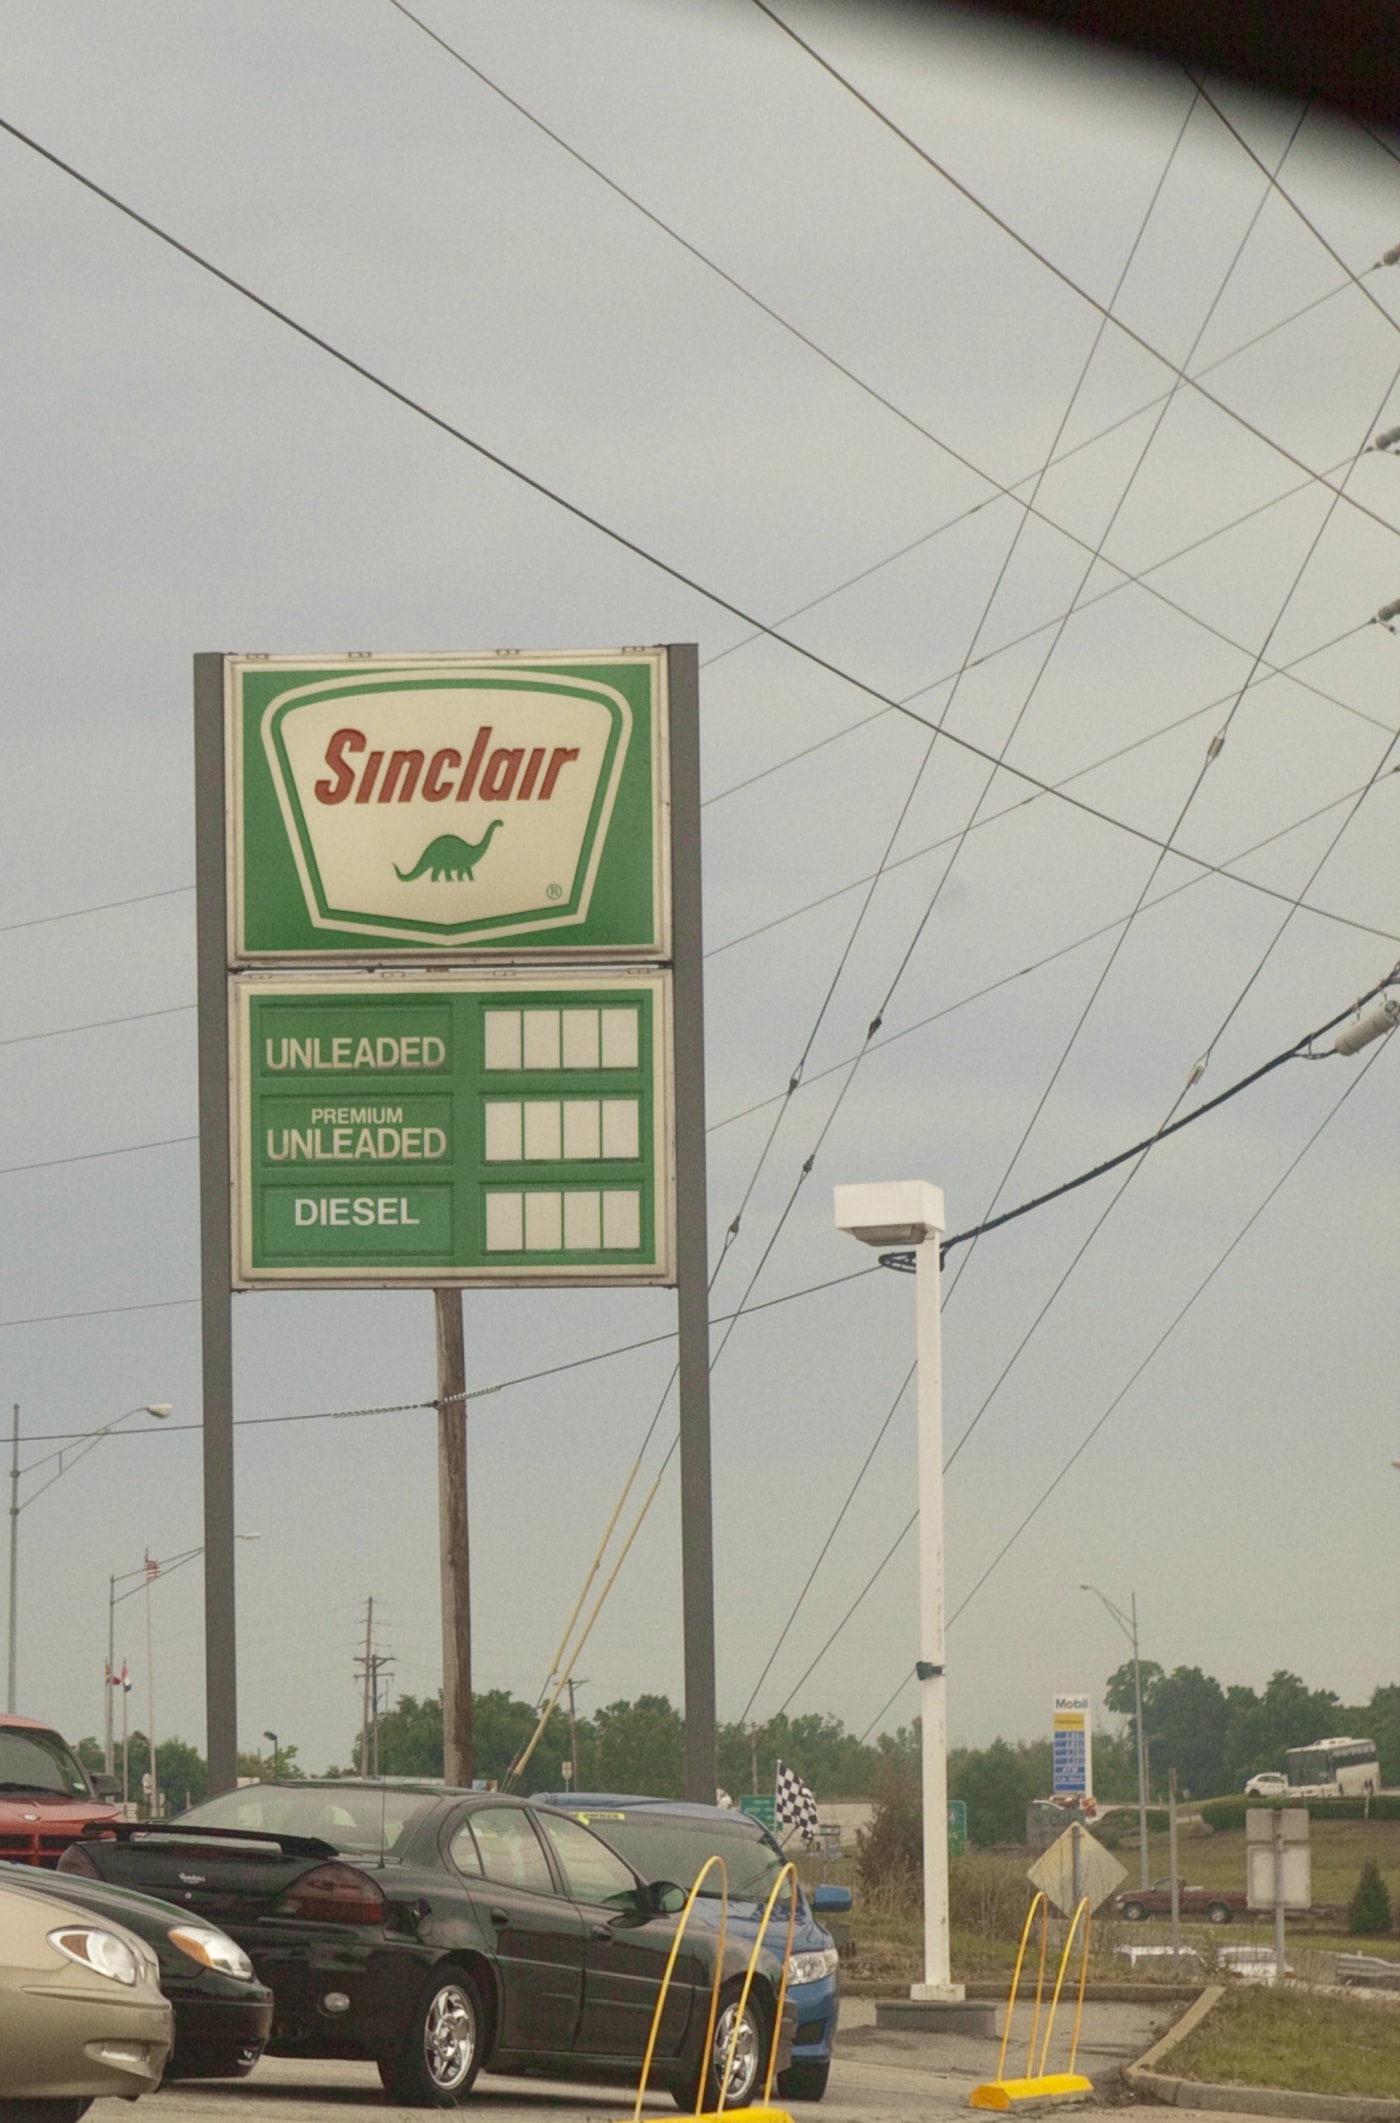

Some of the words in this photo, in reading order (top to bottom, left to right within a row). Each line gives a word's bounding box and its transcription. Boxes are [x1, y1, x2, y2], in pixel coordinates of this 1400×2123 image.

[314, 727, 579, 805] Sinclair
[264, 1036, 447, 1071] UNLEADED
[310, 1107, 404, 1124] PREMIUM
[265, 1127, 448, 1161] UNLEADED
[293, 1197, 421, 1227] DIESEL
[1055, 1698, 1089, 1709] Mobil
